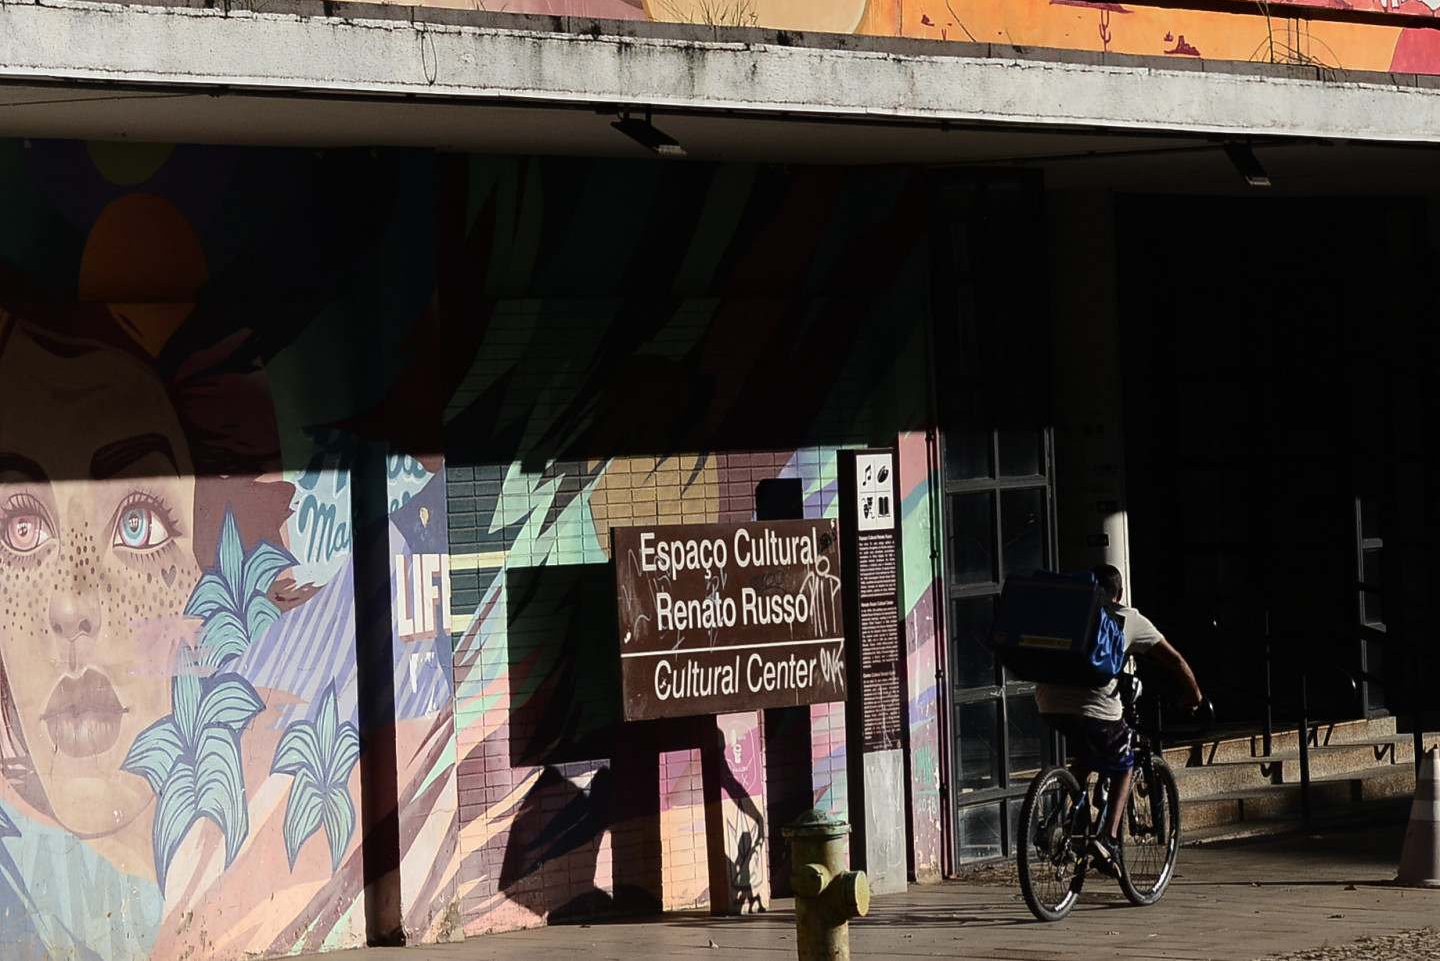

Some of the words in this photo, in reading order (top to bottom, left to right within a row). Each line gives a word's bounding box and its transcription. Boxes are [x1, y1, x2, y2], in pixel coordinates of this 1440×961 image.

[640, 532, 728, 580] Espaço
[733, 527, 818, 568] Cultural
[656, 590, 737, 631] Renato
[741, 588, 809, 625] Russo
[654, 654, 741, 700] Cultural
[746, 653, 817, 693] Center
